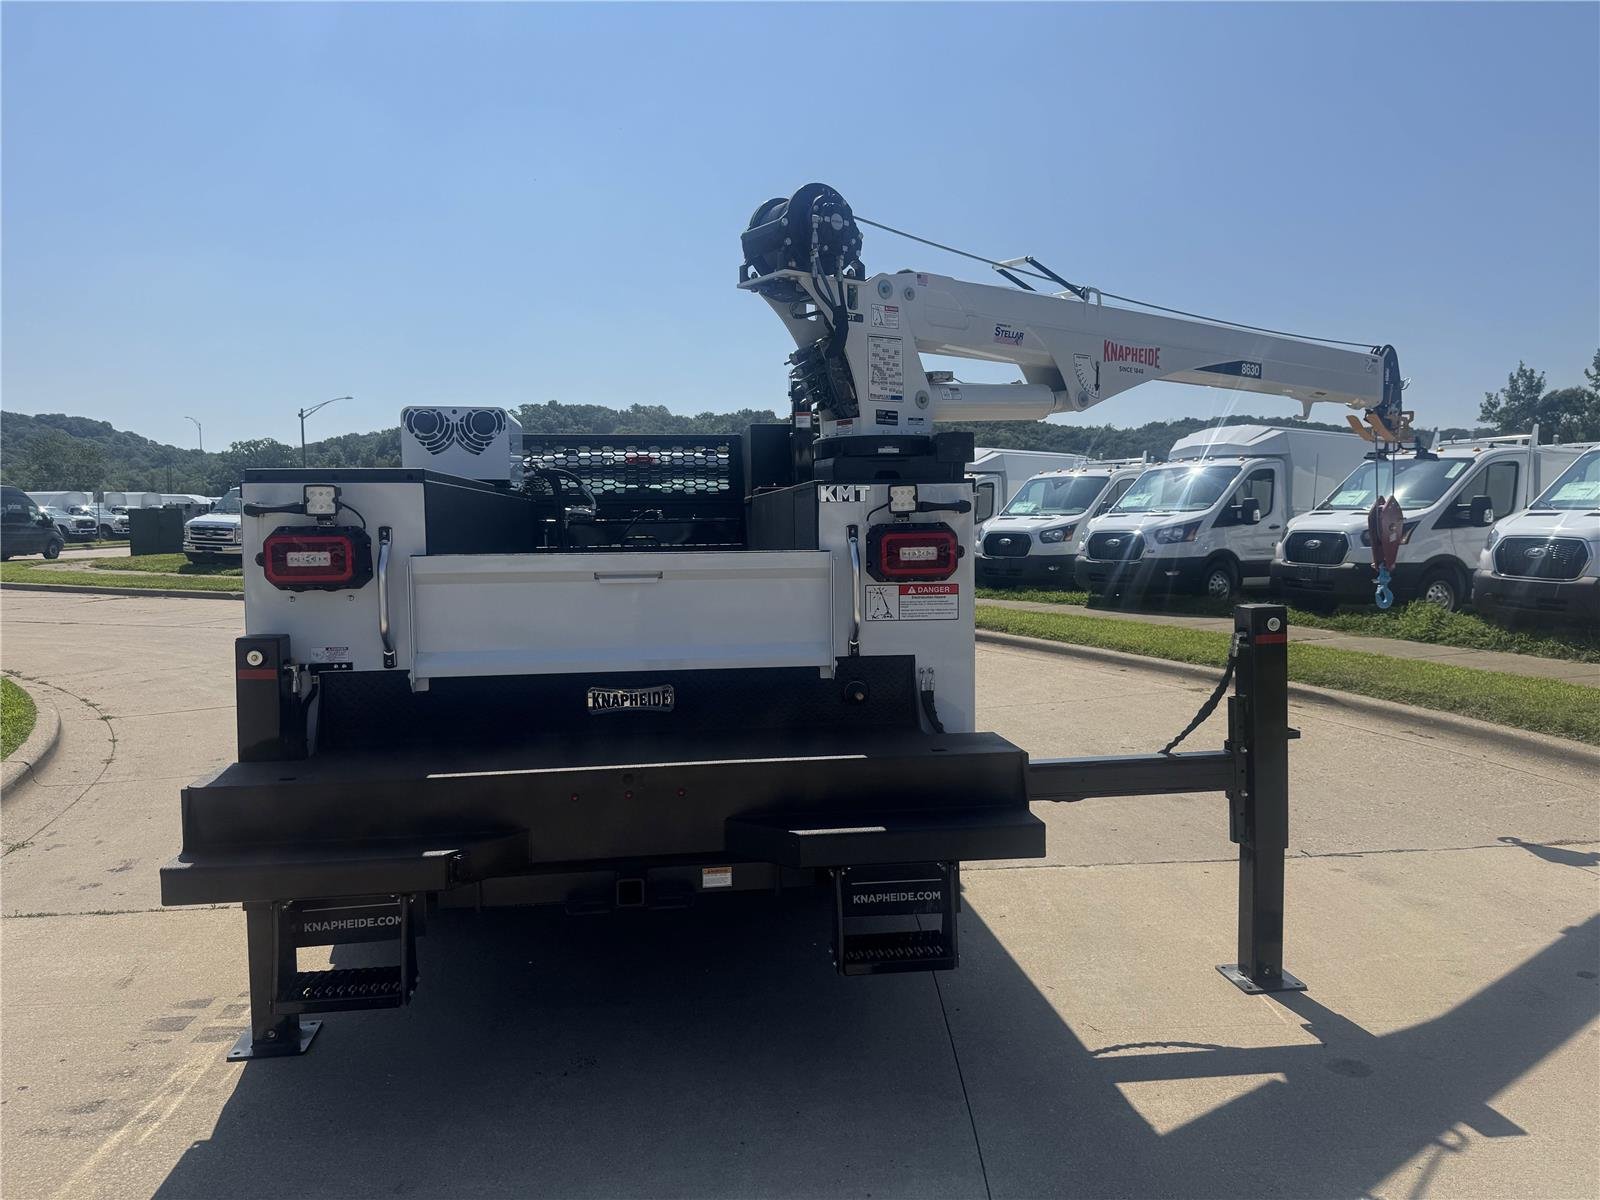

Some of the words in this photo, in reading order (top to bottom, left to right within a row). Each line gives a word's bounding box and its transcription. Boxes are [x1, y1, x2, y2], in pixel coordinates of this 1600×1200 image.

[995, 327, 1024, 340] STELLAR
[1103, 339, 1160, 369] KNAPHEIDE
[1241, 363, 1260, 376] 8630
[820, 484, 871, 502] KMT
[592, 691, 672, 709] KNAPHEIDE
[853, 891, 941, 904] KNAPHEIDE.COM
[303, 916, 402, 932] KNAPHEIDE.COM
